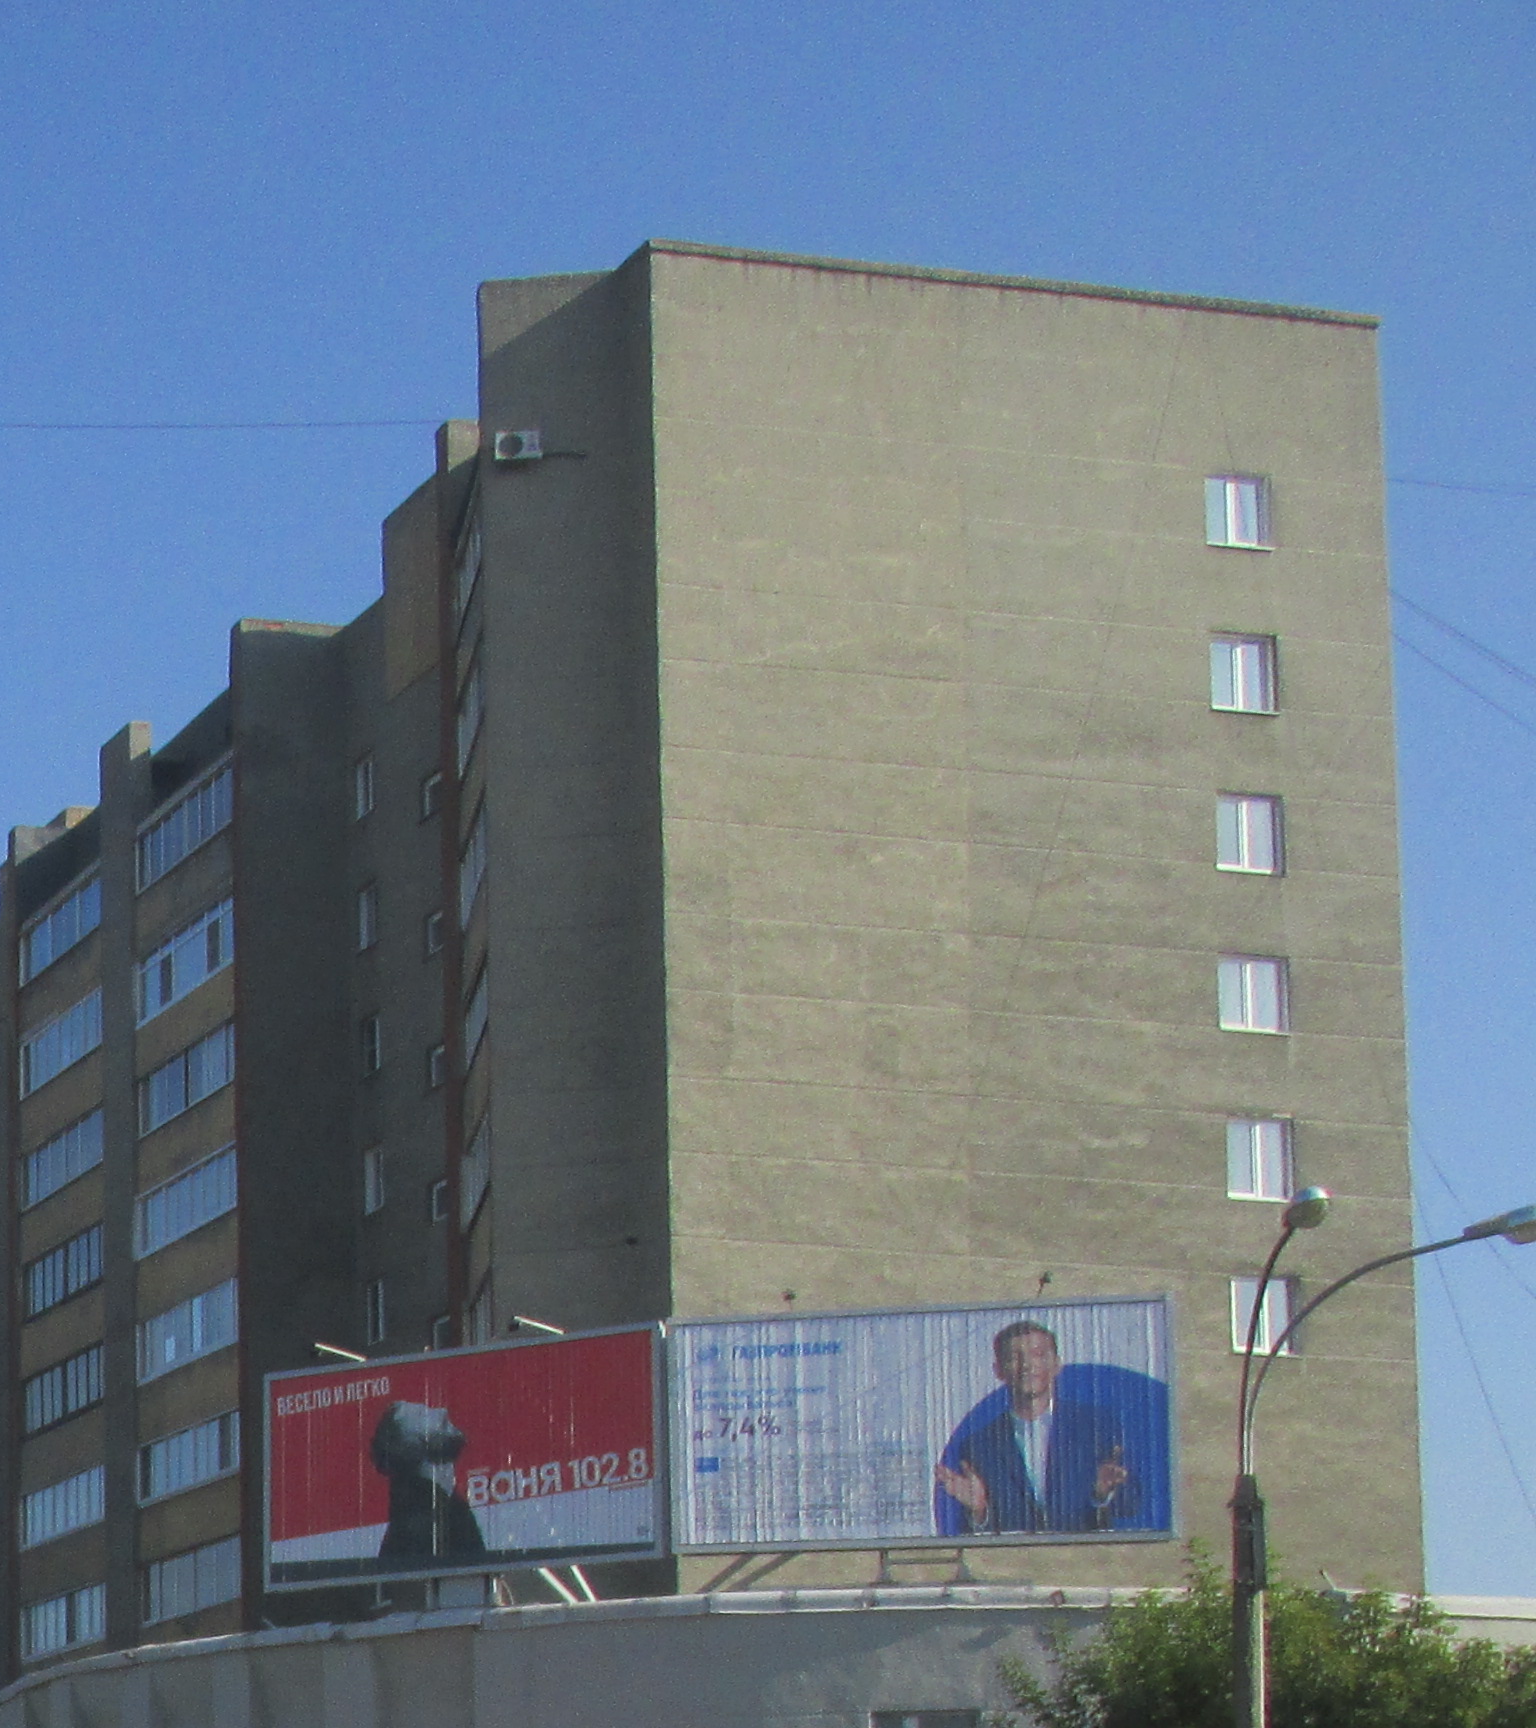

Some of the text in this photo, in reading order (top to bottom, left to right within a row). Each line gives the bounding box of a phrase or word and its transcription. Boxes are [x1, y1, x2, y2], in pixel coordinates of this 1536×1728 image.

[277, 1377, 390, 1416] ВЕСЕЛО И ЛЕГКО
[718, 1413, 781, 1443] 7,4%
[567, 1447, 649, 1490] 102.8
